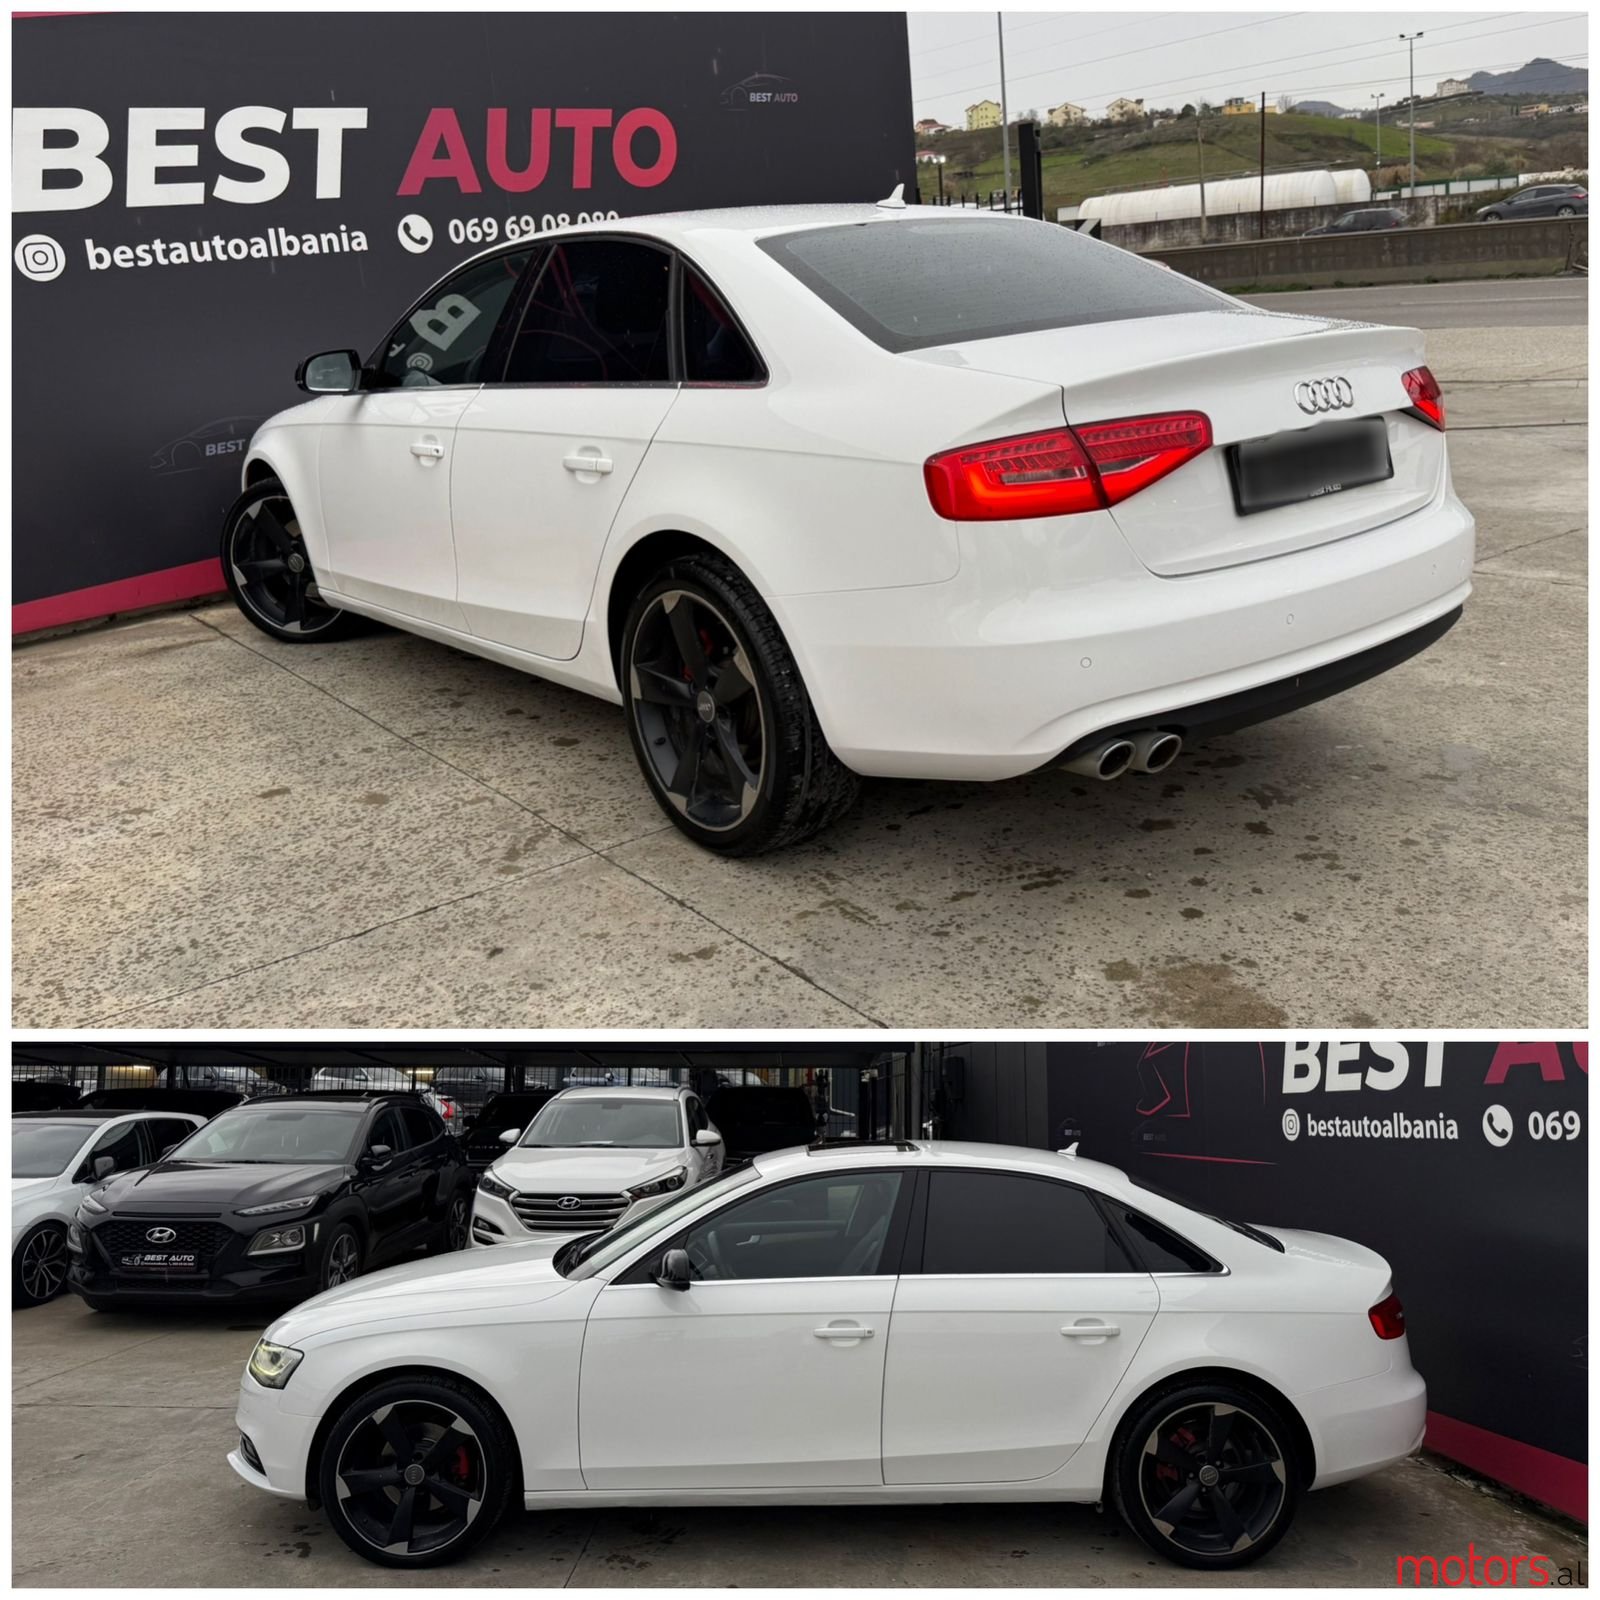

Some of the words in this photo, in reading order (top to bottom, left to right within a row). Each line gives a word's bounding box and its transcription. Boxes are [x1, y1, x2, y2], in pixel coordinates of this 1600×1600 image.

[750, 92, 772, 102] BEST
[774, 93, 798, 102] AUTO
[11, 105, 368, 213] BEST
[396, 106, 678, 196] AUTO
[449, 216, 498, 244] 069
[505, 215, 535, 240] 69
[85, 224, 368, 271] bestautoalbania
[205, 438, 246, 456] BEST
[1307, 1112, 1459, 1140] bestautoalbania
[1528, 1110, 1581, 1140] 069
